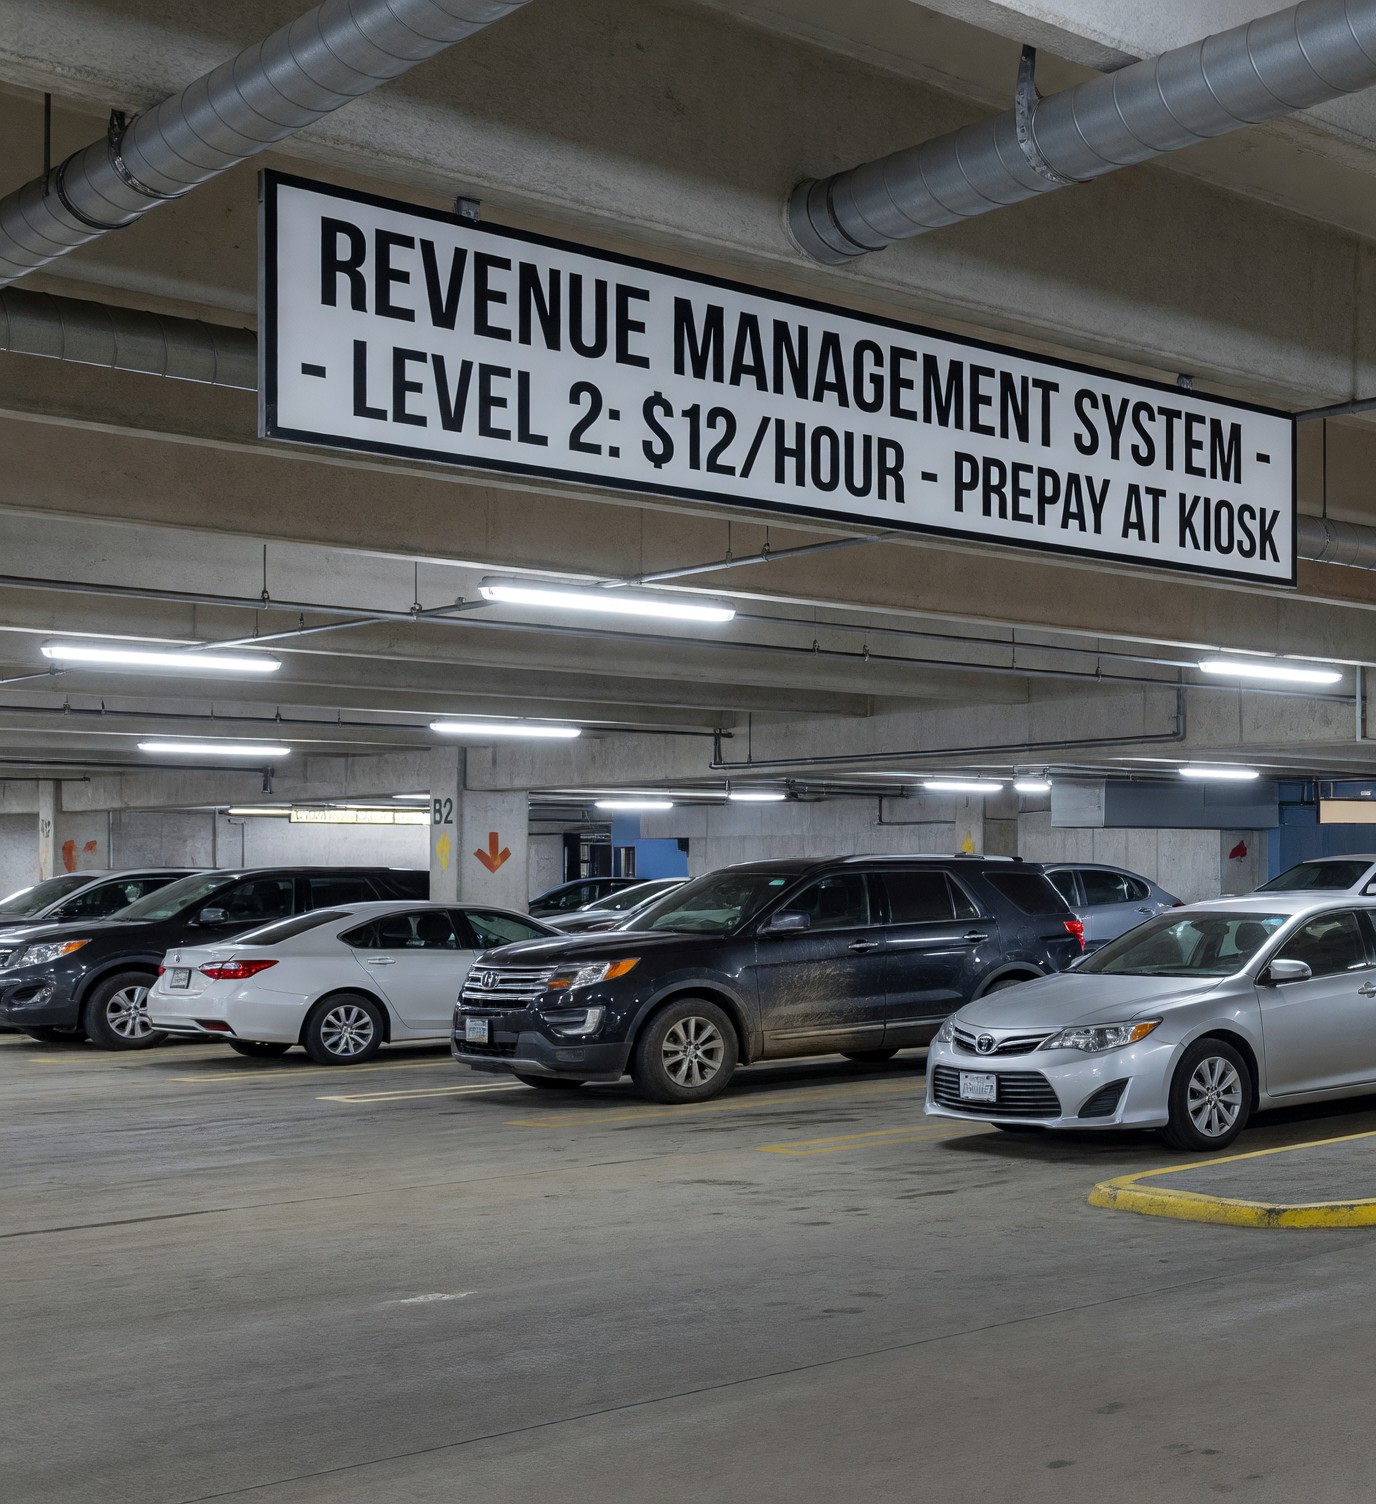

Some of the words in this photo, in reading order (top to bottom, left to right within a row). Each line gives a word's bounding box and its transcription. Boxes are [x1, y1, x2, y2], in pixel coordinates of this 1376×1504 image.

[301, 363, 326, 378] -
[353, 339, 548, 447] LEVEL
[569, 381, 620, 458] 2:
[642, 391, 905, 504] $12/HOUR
[921, 470, 938, 483] -
[955, 451, 1110, 535] PREPAY
[1121, 484, 1166, 544] AT
[1179, 492, 1280, 563] KIOSK
[321, 216, 650, 369] REVENUE
[674, 296, 1059, 447] MANAGEMENT
[1074, 389, 1242, 484] SYSTEM
[1256, 452, 1271, 464] -
[433, 798, 453, 825] B2
